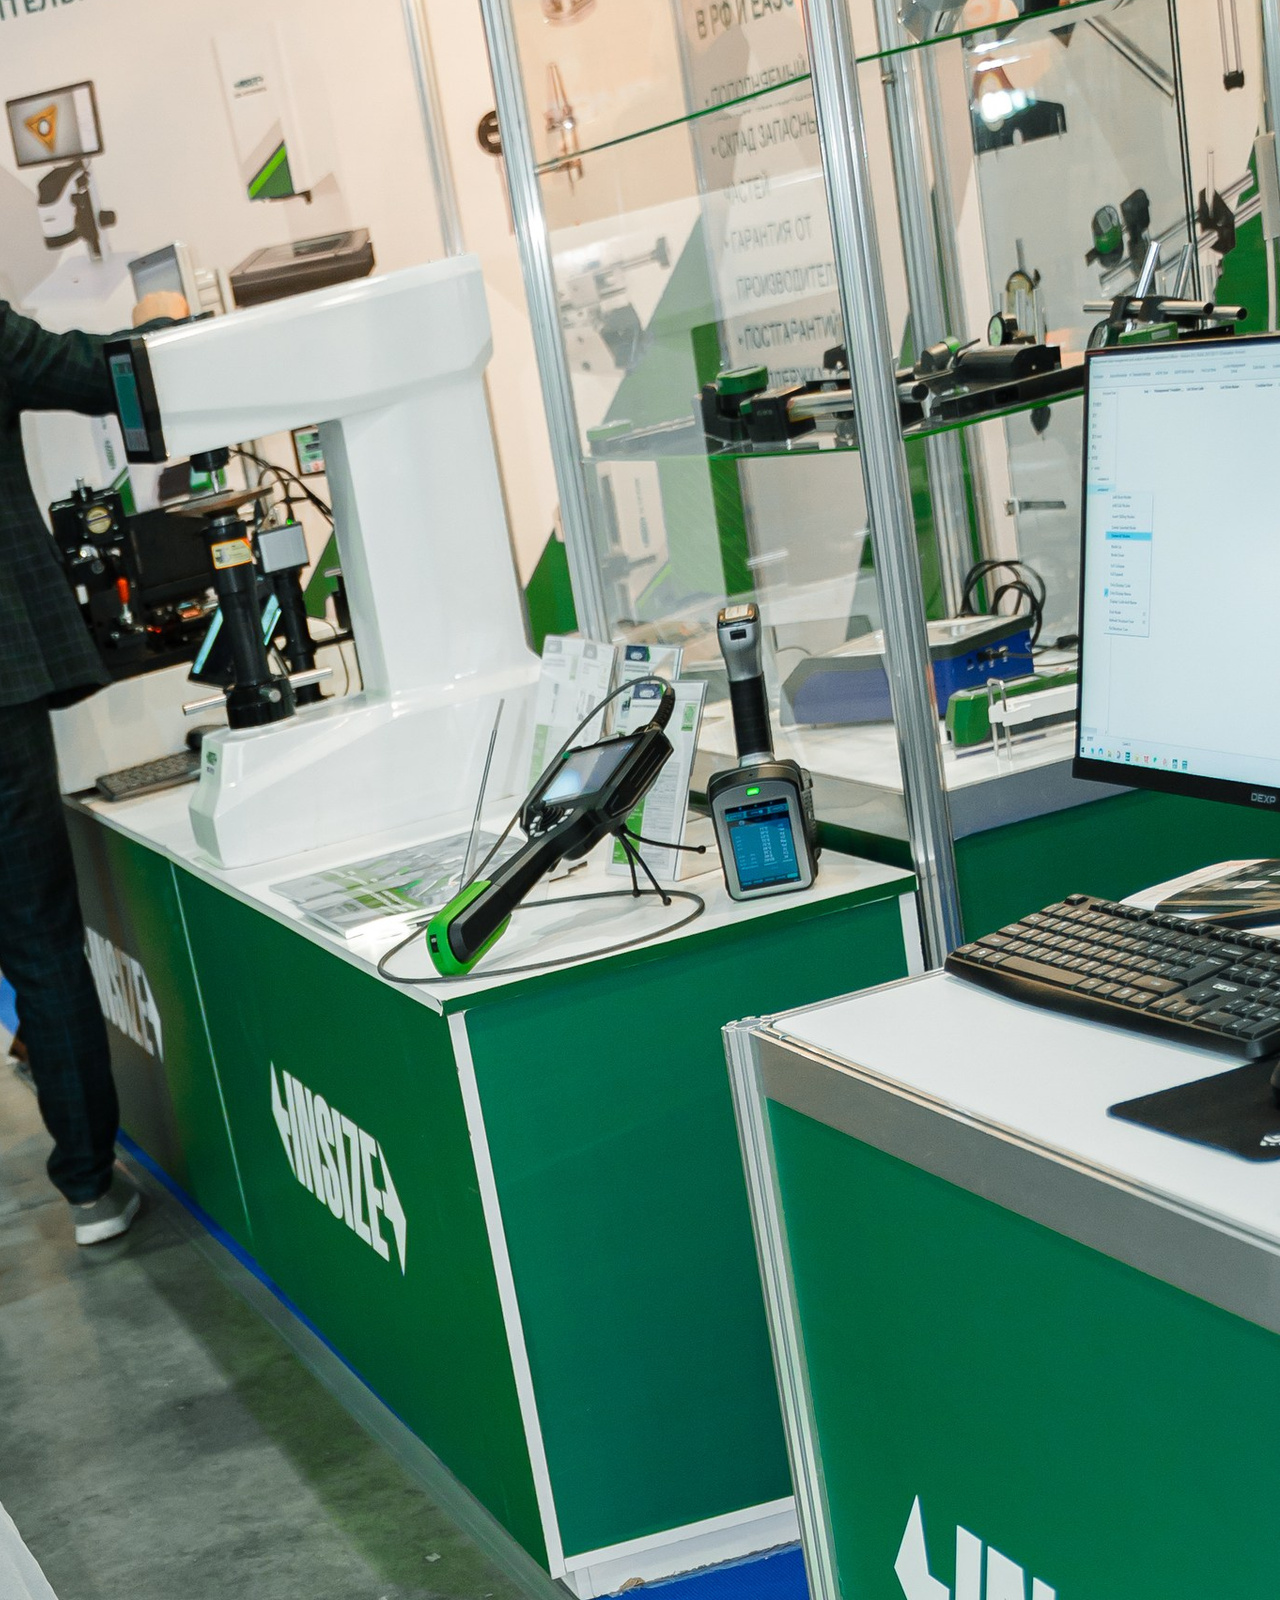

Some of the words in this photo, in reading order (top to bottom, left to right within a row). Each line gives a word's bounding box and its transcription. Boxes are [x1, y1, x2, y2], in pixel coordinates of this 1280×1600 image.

[695, 9, 708, 39] В
[709, 2, 732, 36] РФ
[734, 0, 748, 25] И
[759, 111, 818, 149] ЗАПАСНЫ
[731, 219, 793, 252] ГАРАНТИЯ
[794, 215, 812, 241] ОТ
[736, 262, 836, 300] ПРОИЗВОДИТЕЛ
[1251, 792, 1276, 804] DEXP
[282, 1069, 390, 1262] INSIZE
